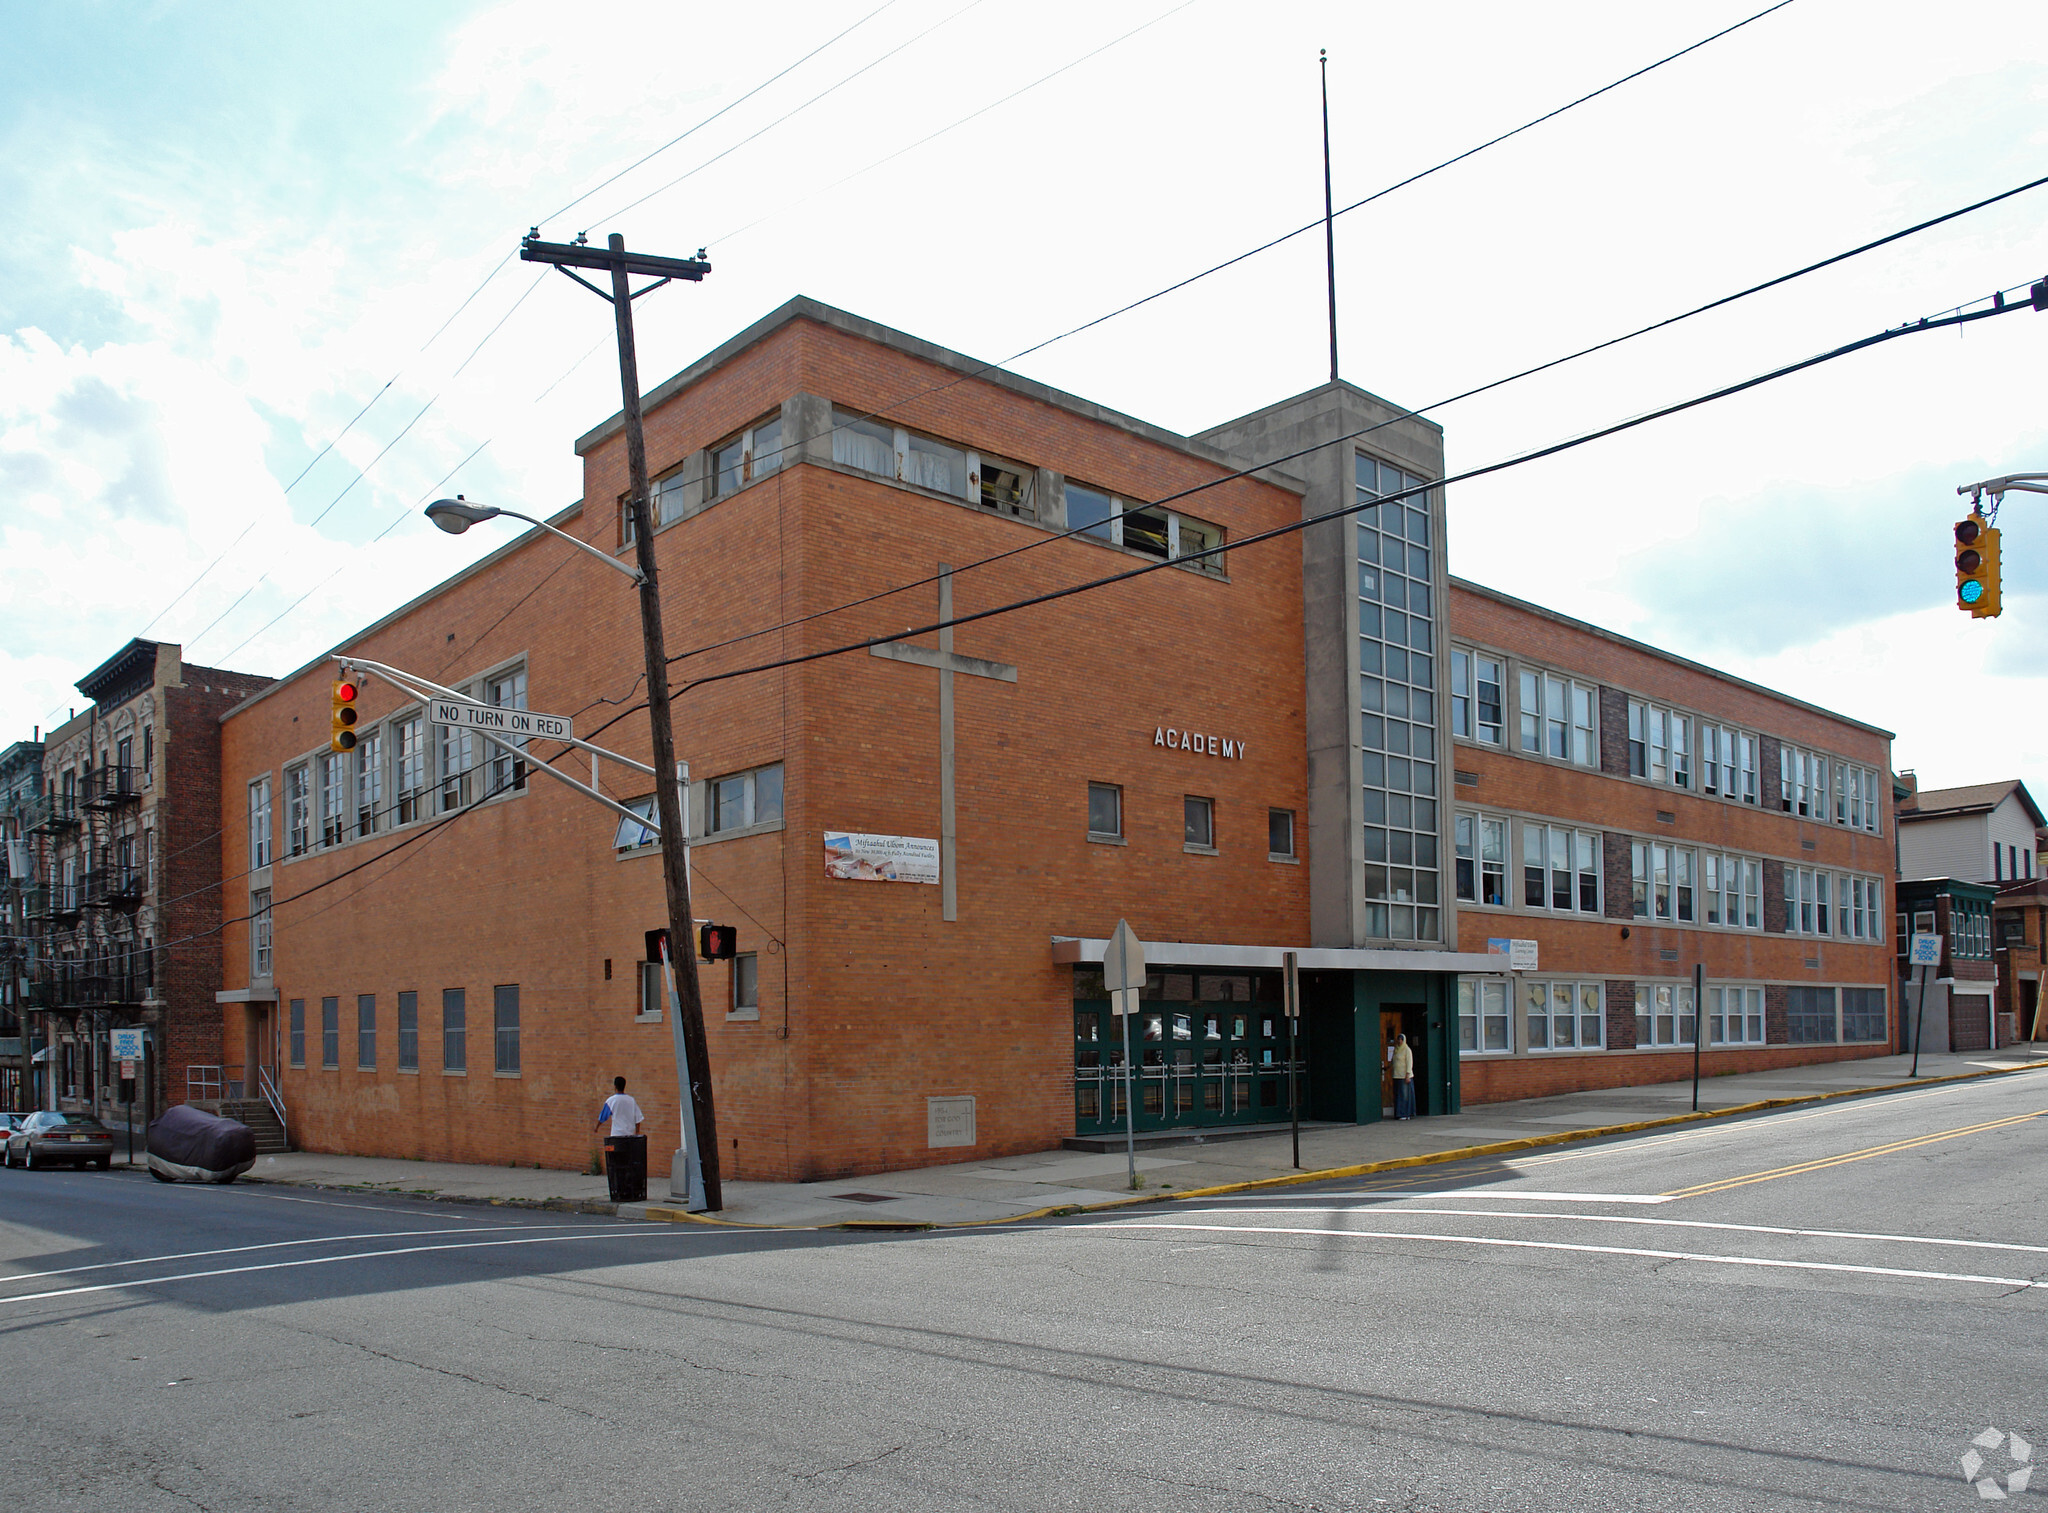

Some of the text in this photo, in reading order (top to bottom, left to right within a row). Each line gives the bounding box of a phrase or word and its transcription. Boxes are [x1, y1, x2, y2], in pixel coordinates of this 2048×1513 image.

[439, 705, 563, 735] NO TURN ON RED
[1154, 727, 1246, 760] ACADEMY
[905, 842, 935, 852] Announces
